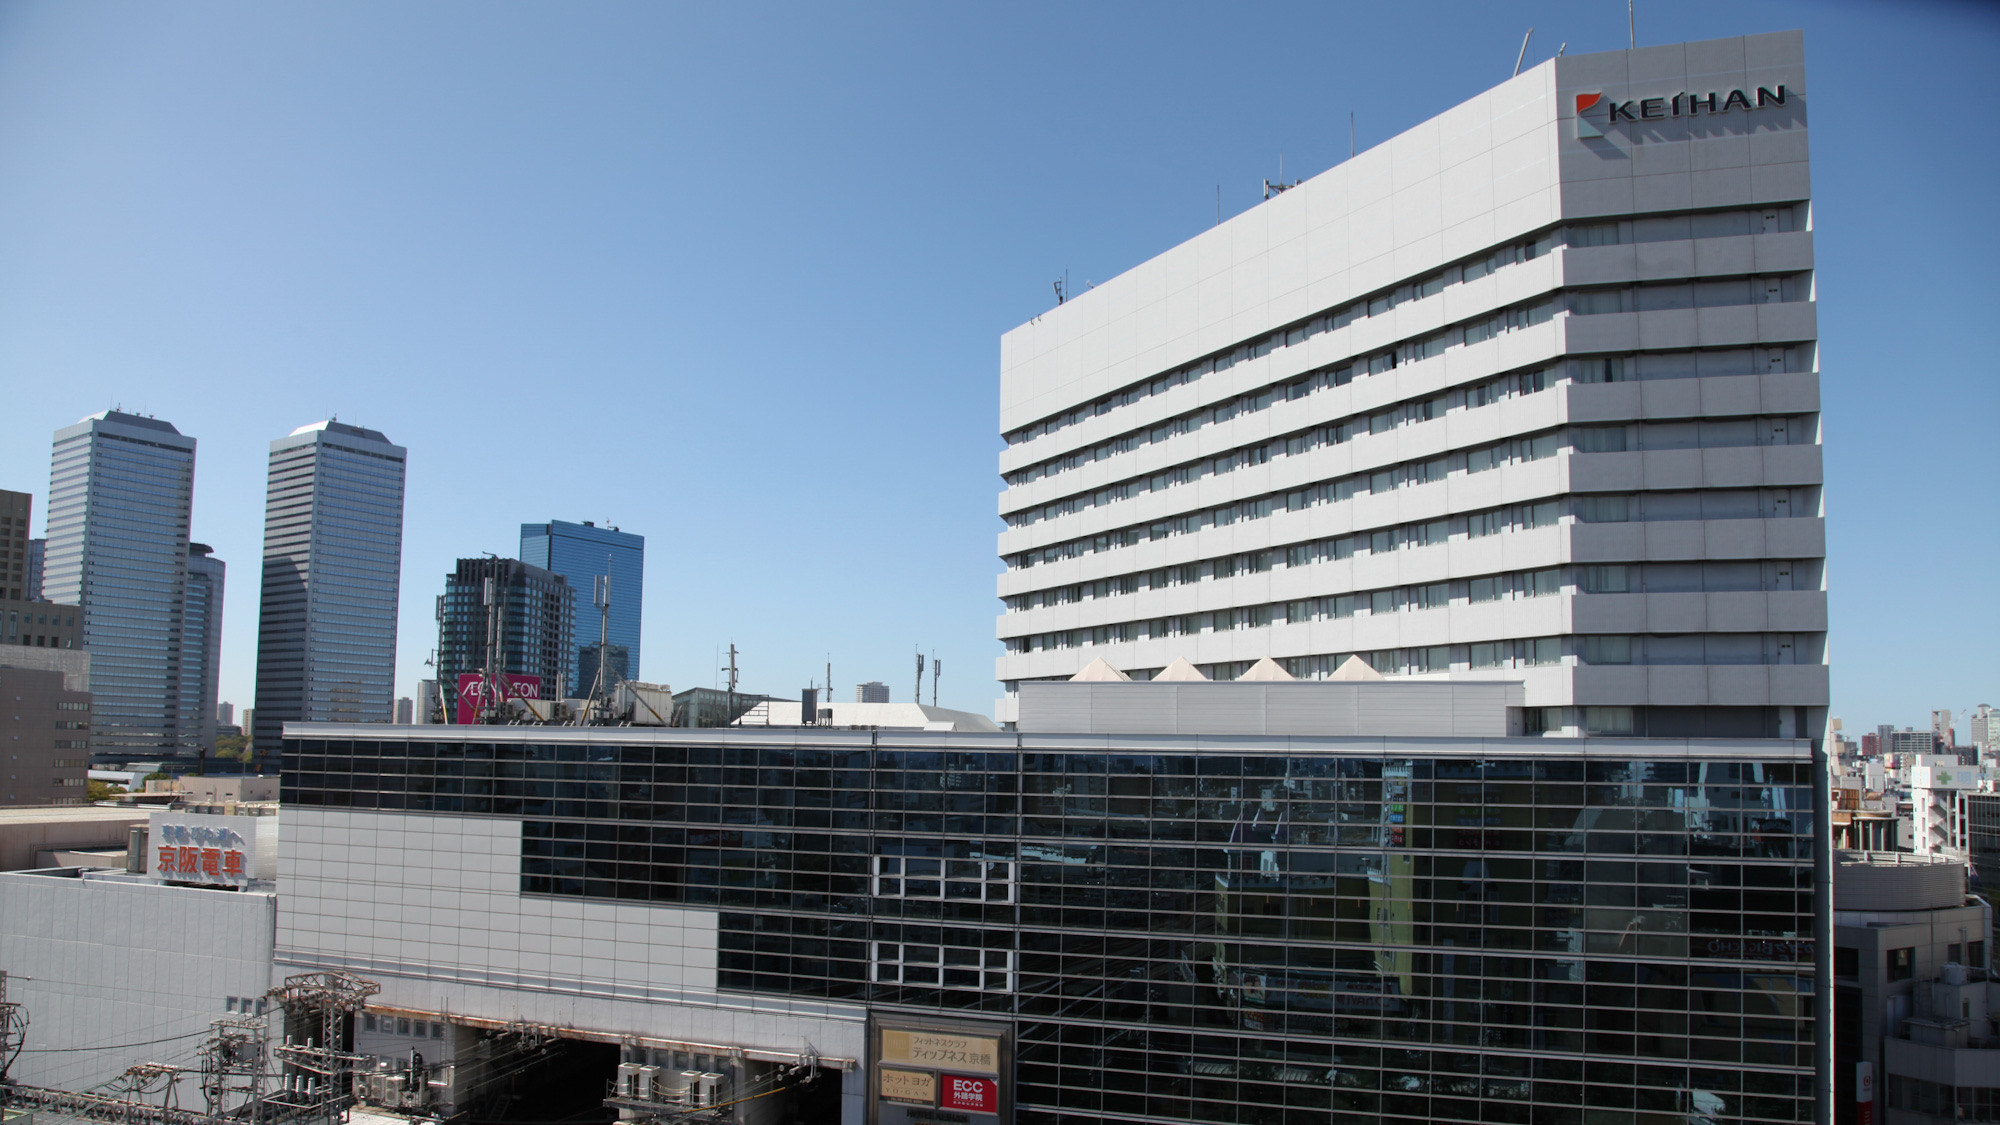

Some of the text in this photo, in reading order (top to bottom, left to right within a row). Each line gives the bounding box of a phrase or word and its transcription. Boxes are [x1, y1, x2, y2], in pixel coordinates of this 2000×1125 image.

[1608, 84, 1786, 123] KEIHAN
[157, 845, 243, 877] 京阪電車
[953, 1079, 983, 1093] ECC
